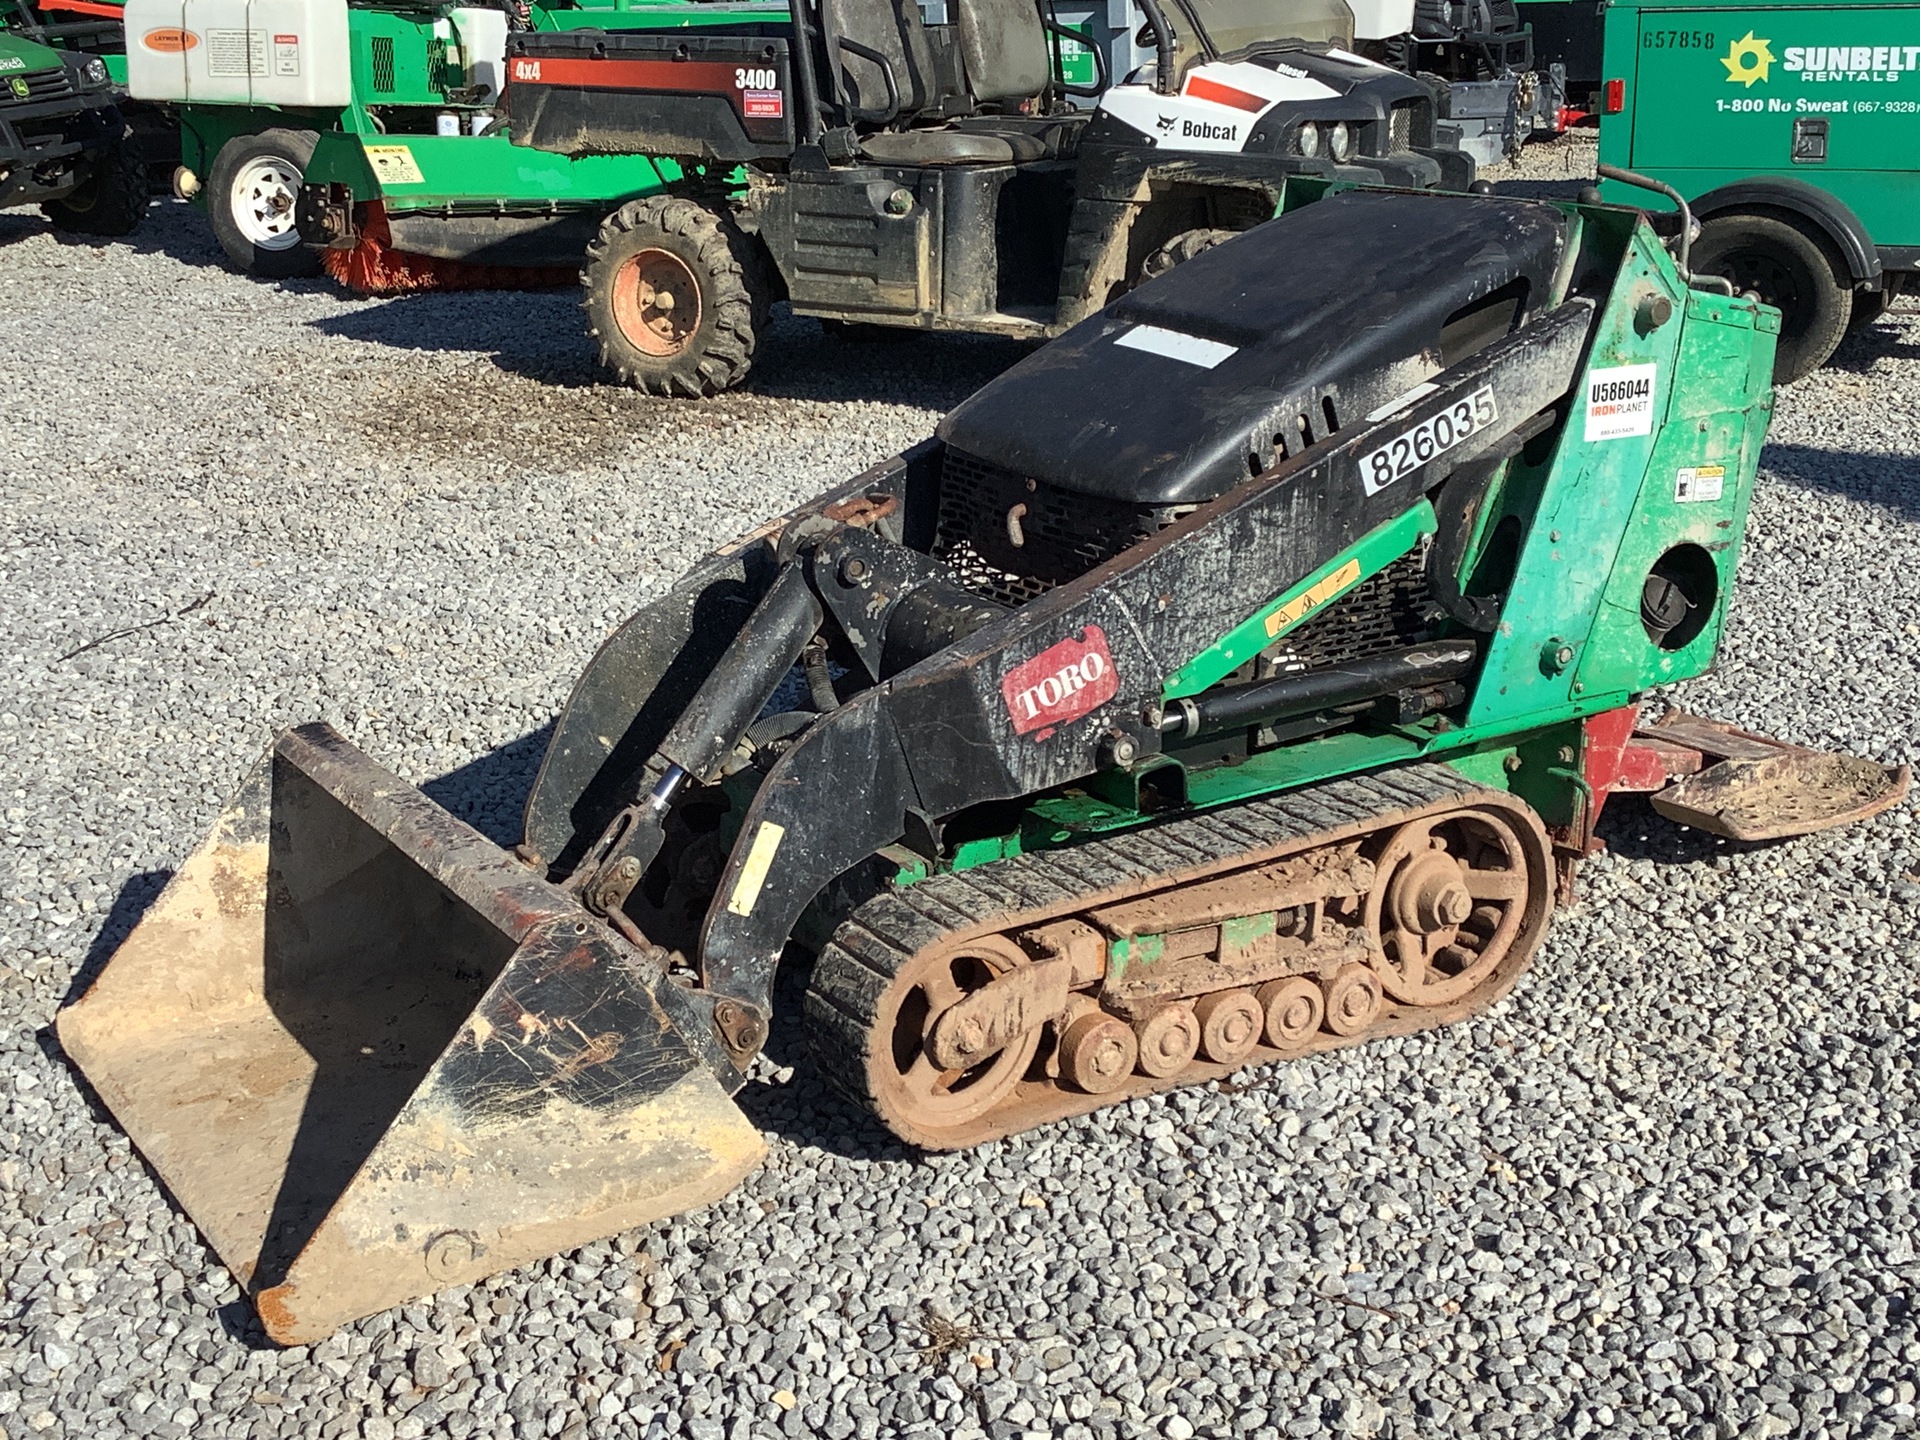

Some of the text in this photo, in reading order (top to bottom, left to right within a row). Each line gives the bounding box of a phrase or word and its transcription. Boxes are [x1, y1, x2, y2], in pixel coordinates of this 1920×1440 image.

[1643, 31, 1715, 50] 657858
[1783, 46, 1920, 71] SUNBELT
[515, 61, 541, 80] 4x4
[735, 68, 776, 90] 3400
[1276, 62, 1309, 79] Diesel
[1801, 71, 1899, 82] RENTALS
[1716, 99, 1764, 112] 1-800
[1768, 98, 1792, 113] No
[1795, 98, 1849, 113] Sweat
[1182, 120, 1238, 141] Bobcat
[1592, 379, 1650, 403] U586044
[1371, 386, 1495, 487] 826035
[1016, 652, 1104, 721] TORO
